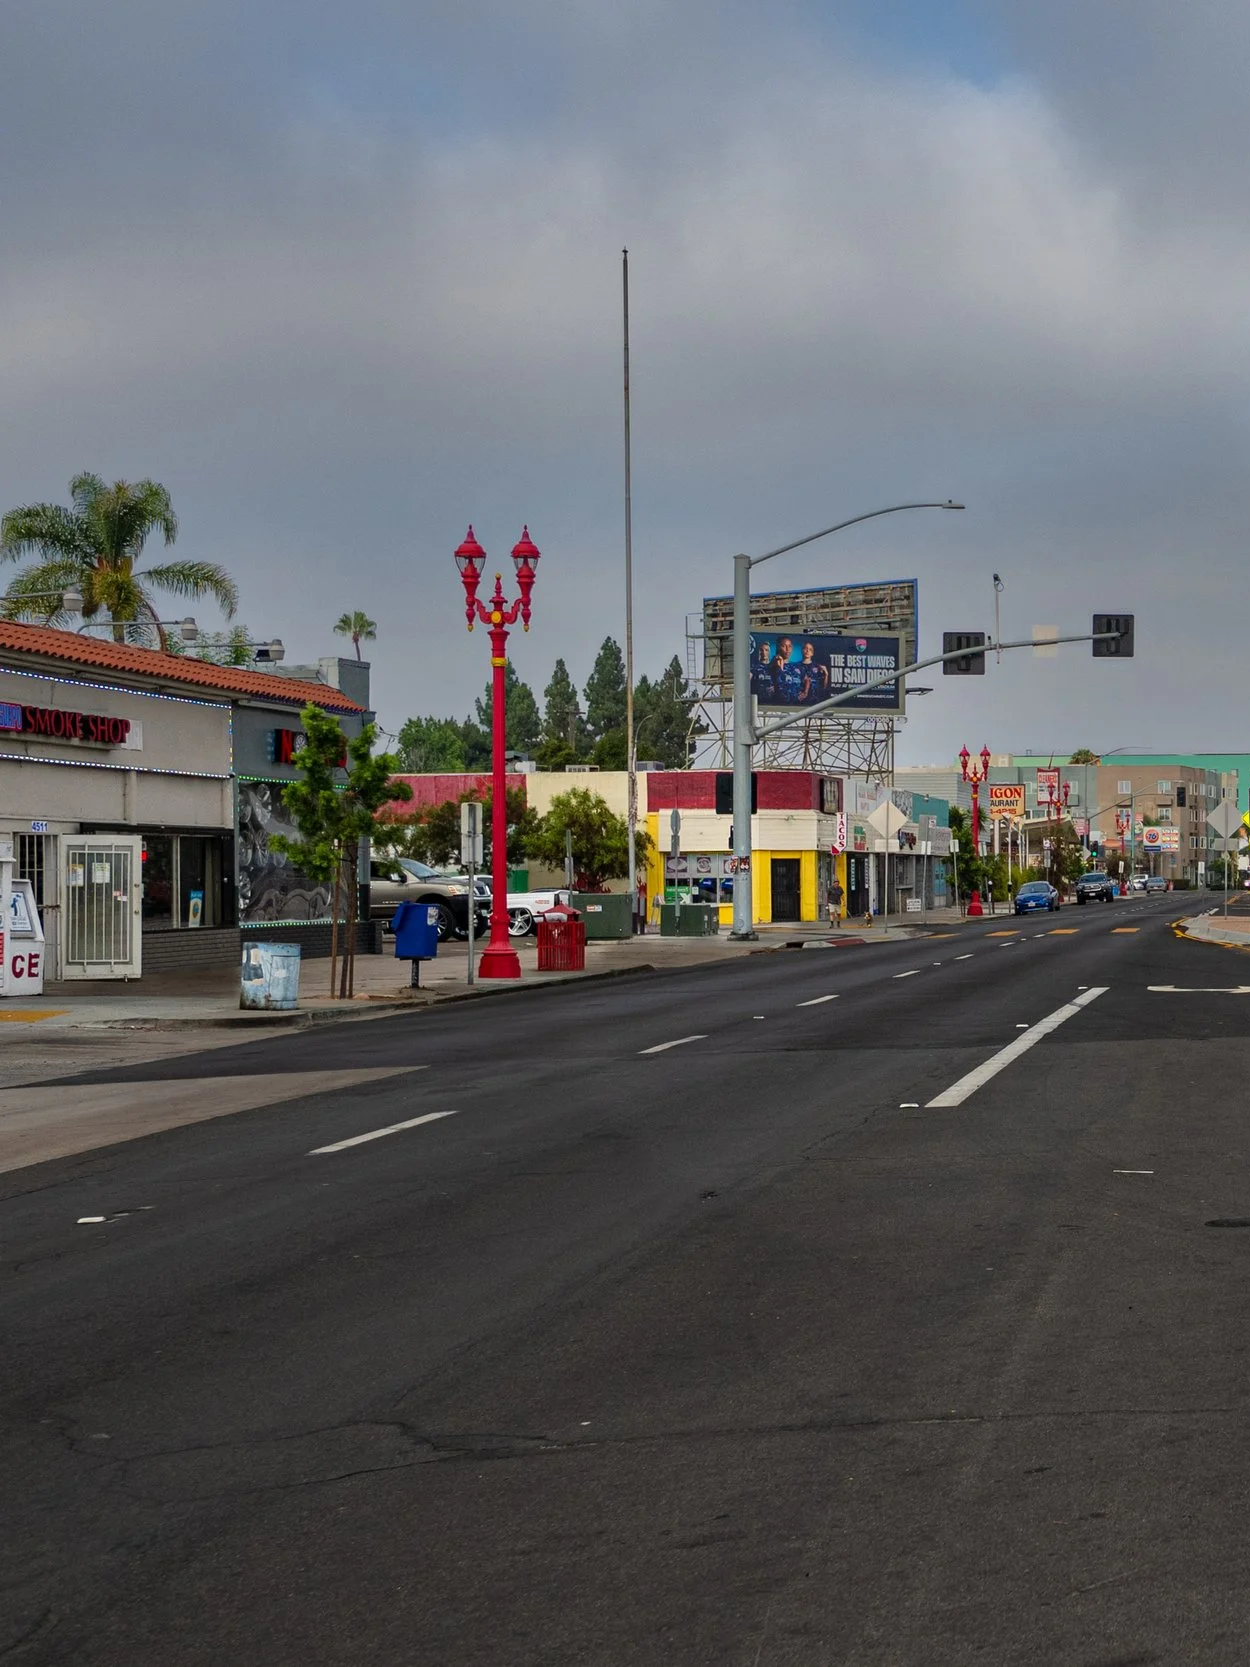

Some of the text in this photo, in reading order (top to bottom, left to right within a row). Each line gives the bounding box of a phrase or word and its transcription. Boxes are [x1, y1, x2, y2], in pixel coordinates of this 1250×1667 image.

[830, 654, 895, 668] THE BEST WAVES
[831, 667, 843, 683] IN
[844, 668, 865, 684] SAN
[25, 705, 83, 739] SMOKE
[88, 714, 131, 743] SHOP
[990, 787, 1022, 799] IGON
[32, 822, 48, 831] 4511
[1148, 832, 1157, 840] 76
